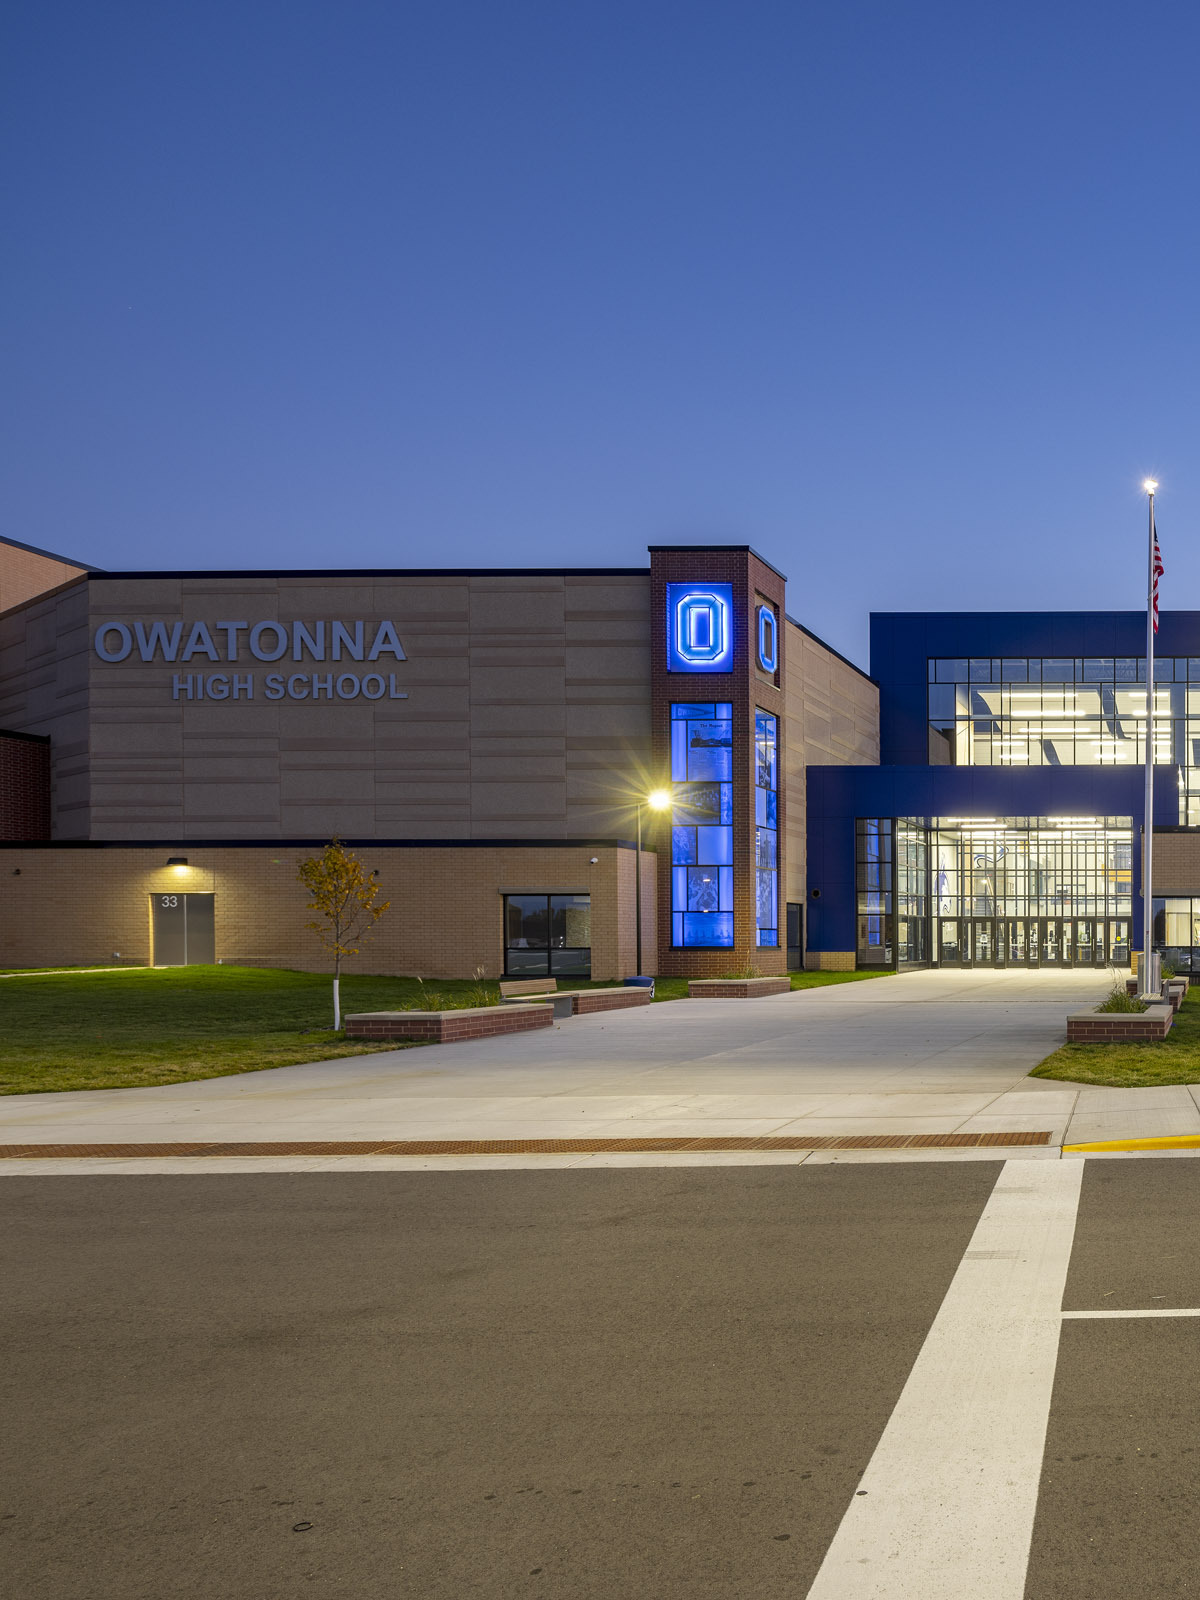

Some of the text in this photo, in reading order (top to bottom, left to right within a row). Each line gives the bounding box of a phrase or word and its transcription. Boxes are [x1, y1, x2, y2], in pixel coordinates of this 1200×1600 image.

[94, 620, 408, 663] OWATONNA
[677, 593, 725, 661] O
[758, 605, 777, 674] O
[172, 673, 409, 700] HIGH SCHOOL
[162, 895, 178, 908] 33
